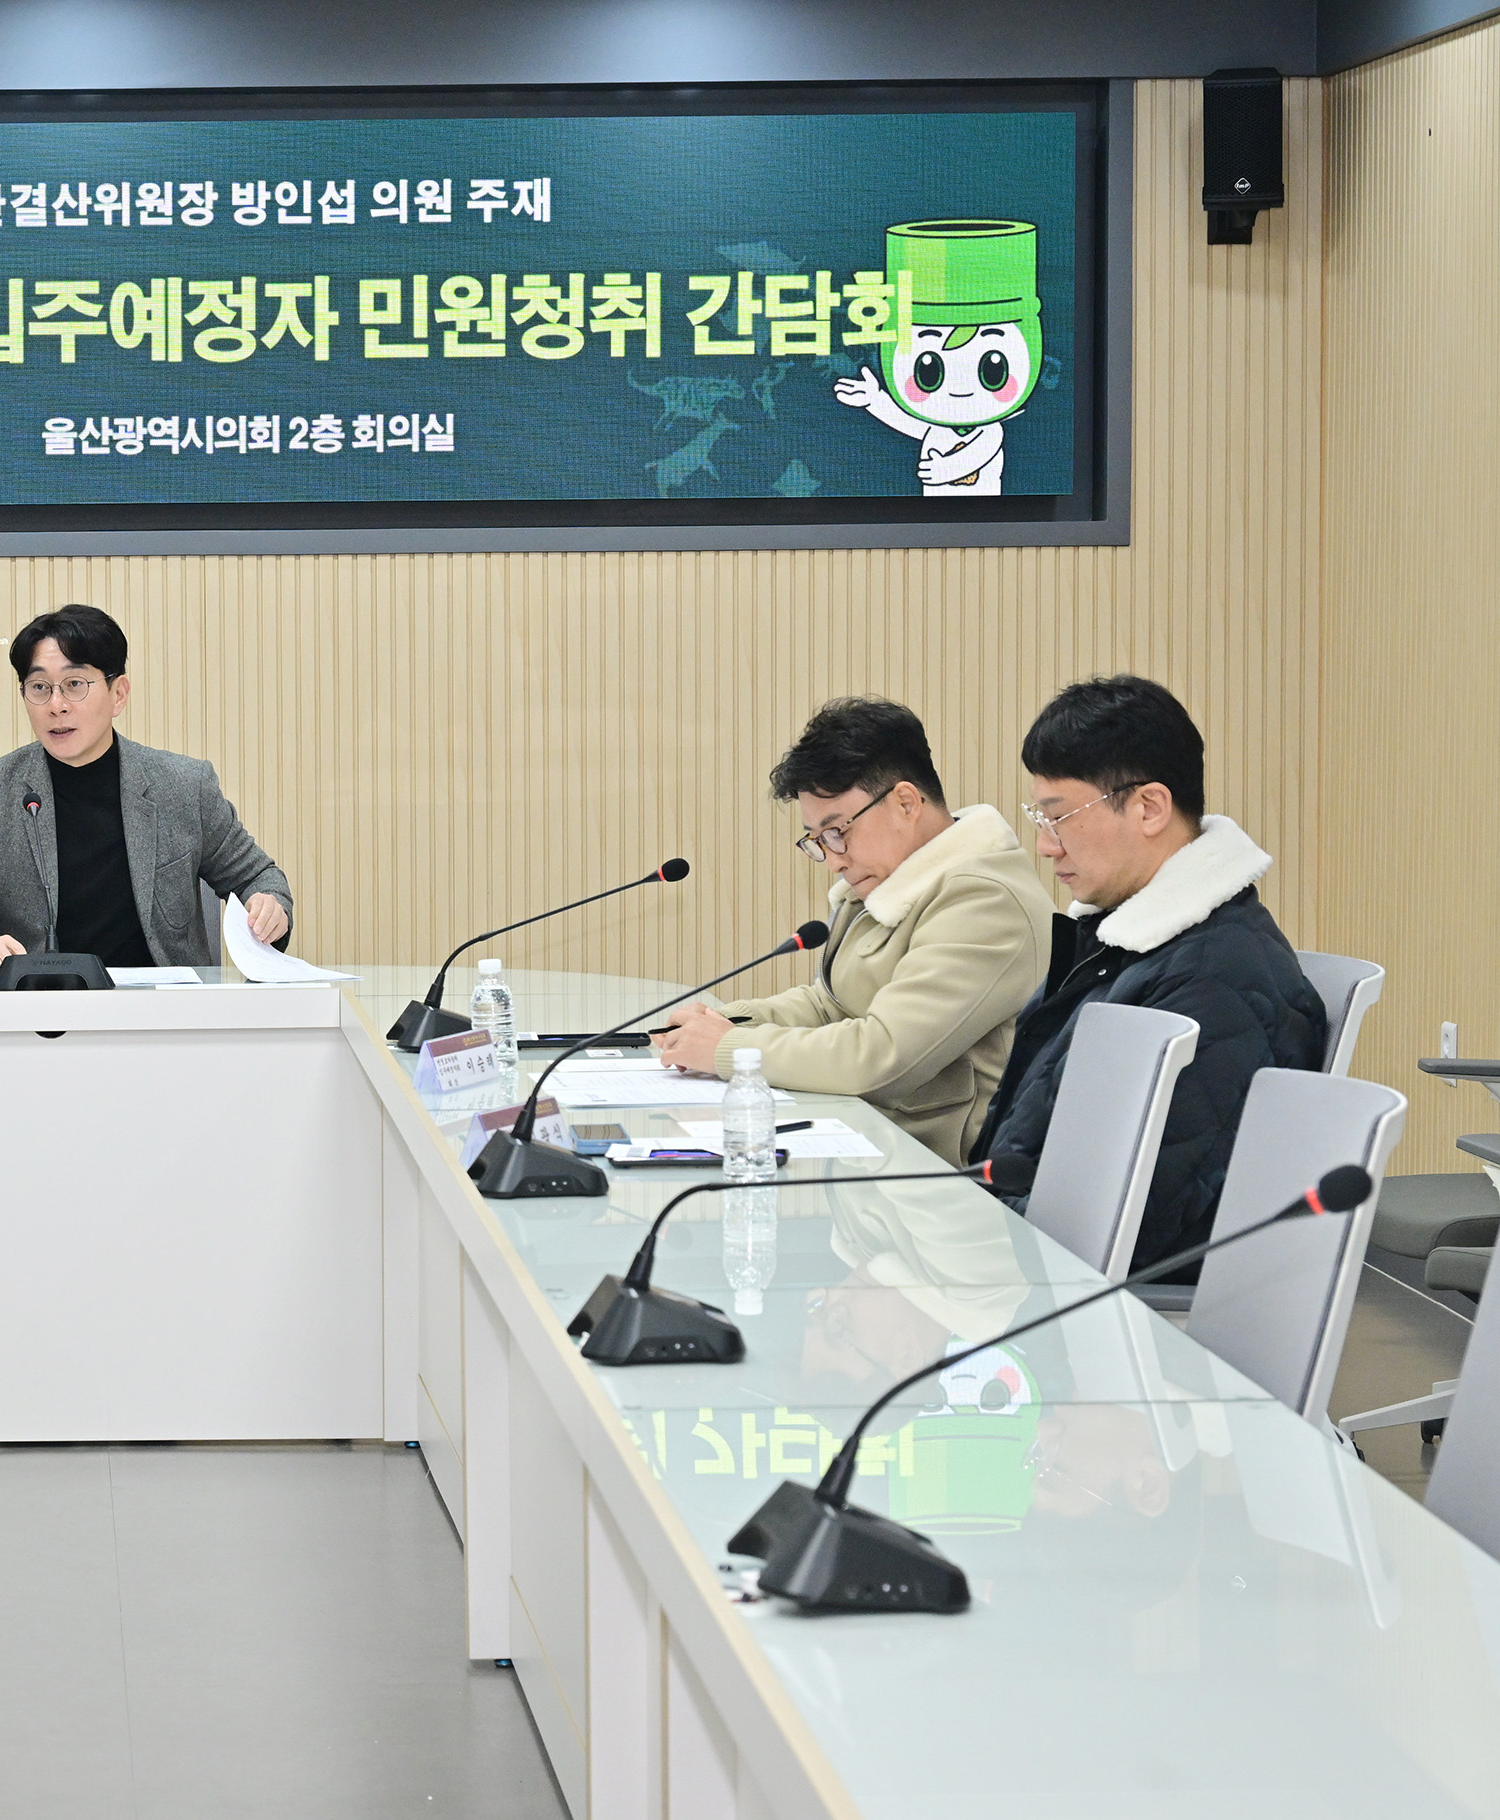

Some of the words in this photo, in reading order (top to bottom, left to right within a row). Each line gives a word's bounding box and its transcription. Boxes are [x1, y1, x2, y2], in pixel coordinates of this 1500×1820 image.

[231, 179, 356, 225] 방인섭
[370, 178, 452, 223] 의원
[466, 177, 551, 222] 주재
[359, 272, 661, 360] 민원청취
[686, 270, 913, 355] 간담회
[41, 414, 280, 455] 울산광역시의회
[288, 413, 345, 454] 2층
[351, 413, 455, 453] 회의실
